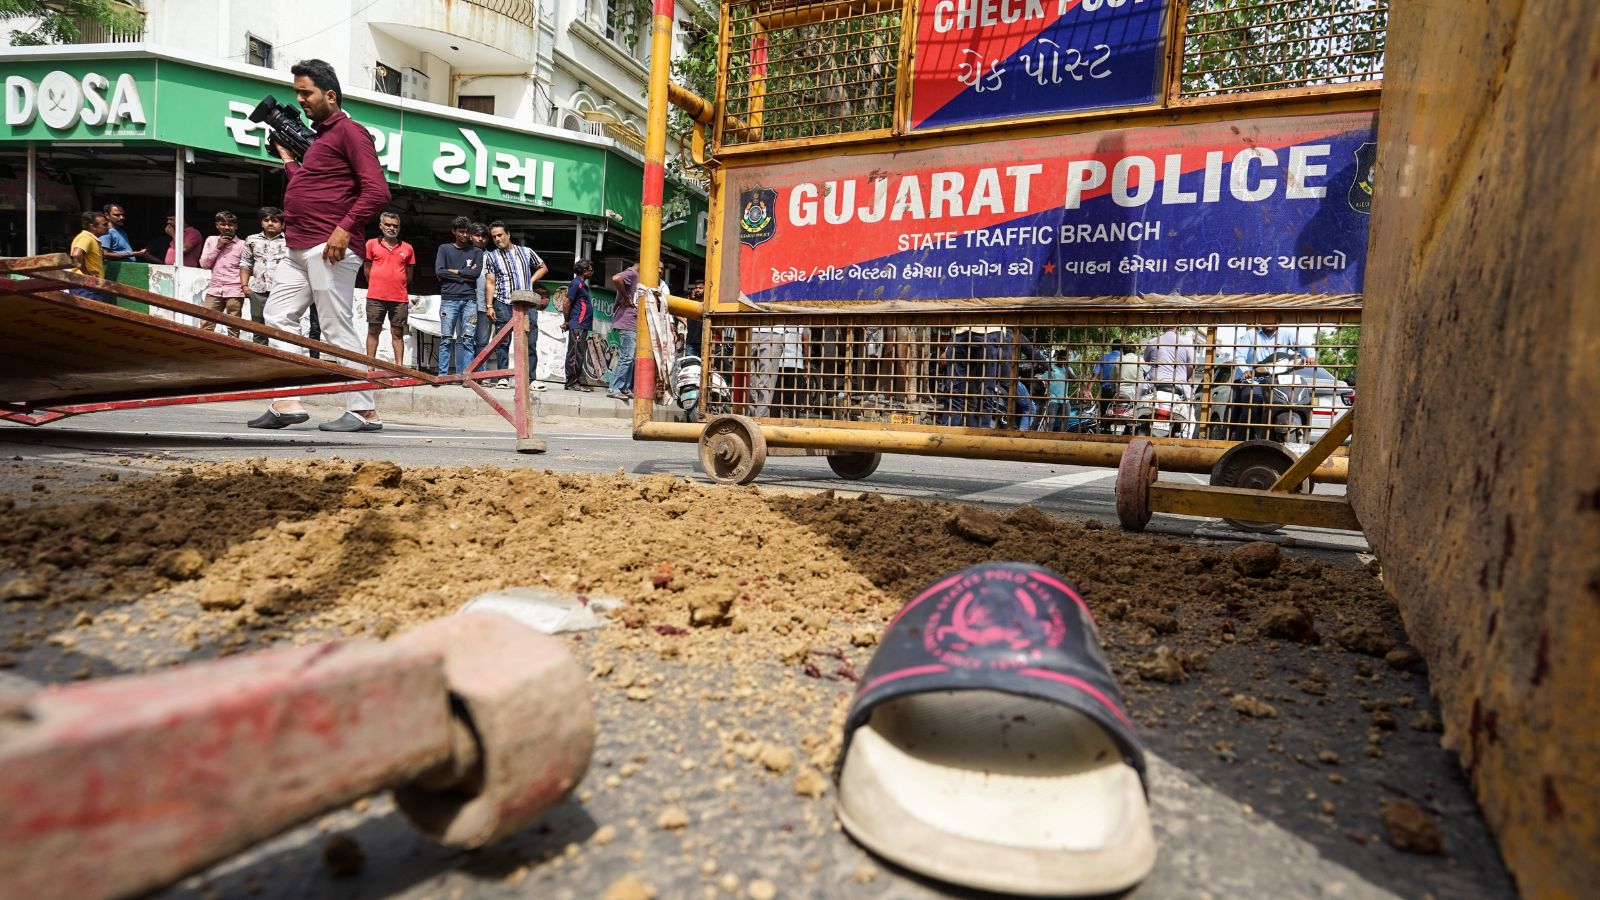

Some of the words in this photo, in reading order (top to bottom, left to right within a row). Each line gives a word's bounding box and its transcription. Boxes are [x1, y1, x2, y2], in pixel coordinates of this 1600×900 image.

[933, 0, 1045, 33] CHECK
[957, 48, 1006, 93] ચેક
[1020, 38, 1112, 86] પોસ્ટ
[5, 70, 147, 130] DOSA
[432, 128, 555, 200] ઢોસા
[788, 163, 1043, 228] GUJARAT
[1064, 143, 1332, 211] POLICE
[897, 230, 957, 252] STATE
[966, 225, 1054, 248] TRAFFIC
[1059, 220, 1162, 244] BRANCH
[948, 258, 1002, 278] ઉપયોગ
[1007, 256, 1034, 276] કરો
[1065, 259, 1111, 275] વાહન
[1174, 252, 1220, 273] ડાબી
[1226, 255, 1272, 276] બાજુ
[1277, 249, 1347, 271] ચલાવો
